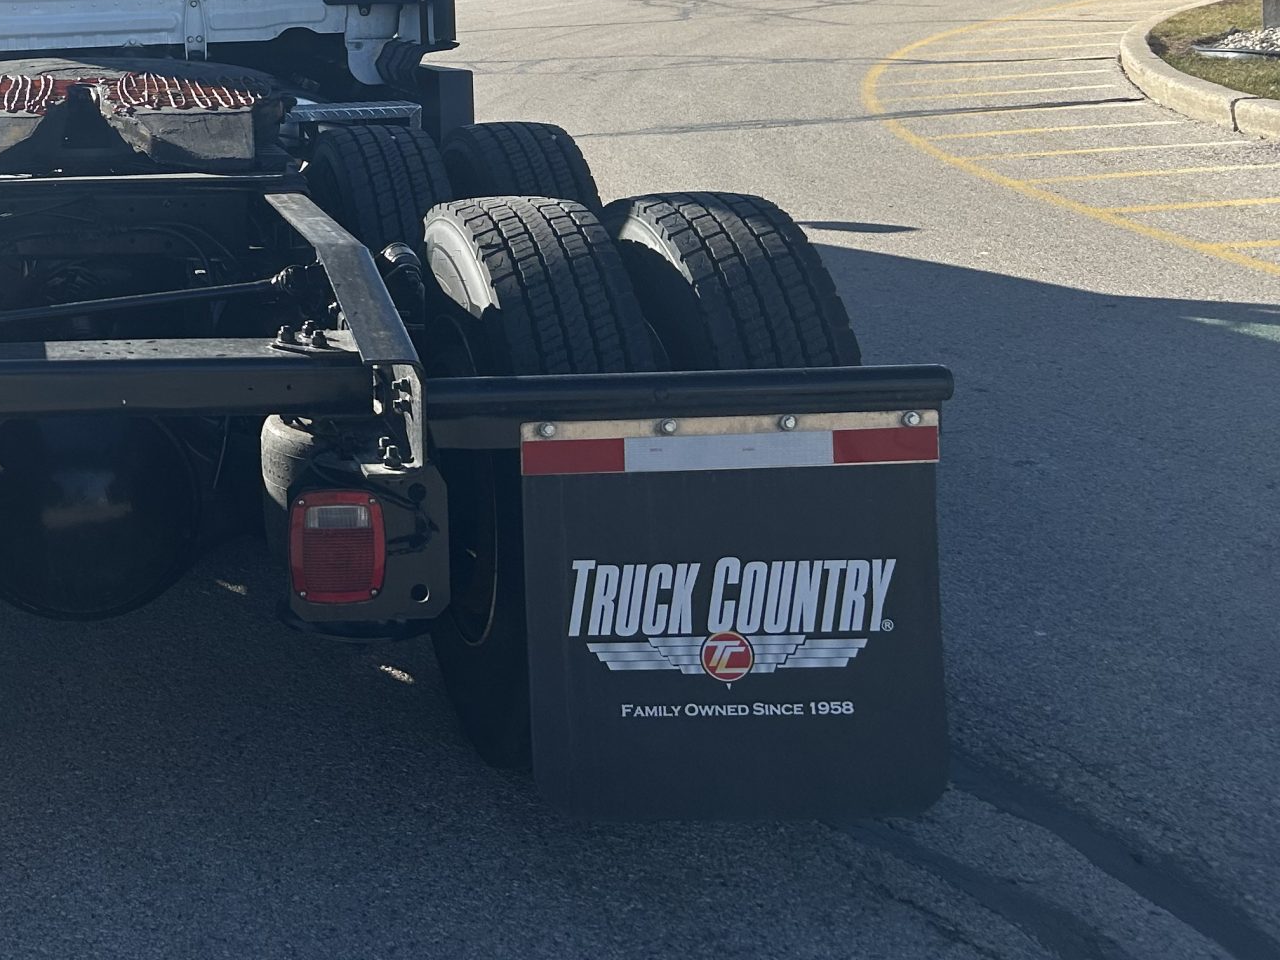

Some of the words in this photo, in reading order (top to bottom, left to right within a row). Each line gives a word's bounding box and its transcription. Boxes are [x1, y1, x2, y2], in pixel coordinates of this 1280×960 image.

[568, 559, 701, 637] TRUCK
[621, 703, 682, 718] FAMILY
[684, 702, 749, 717] OWNED
[752, 702, 804, 716] SINCE
[808, 701, 855, 715] 1958
